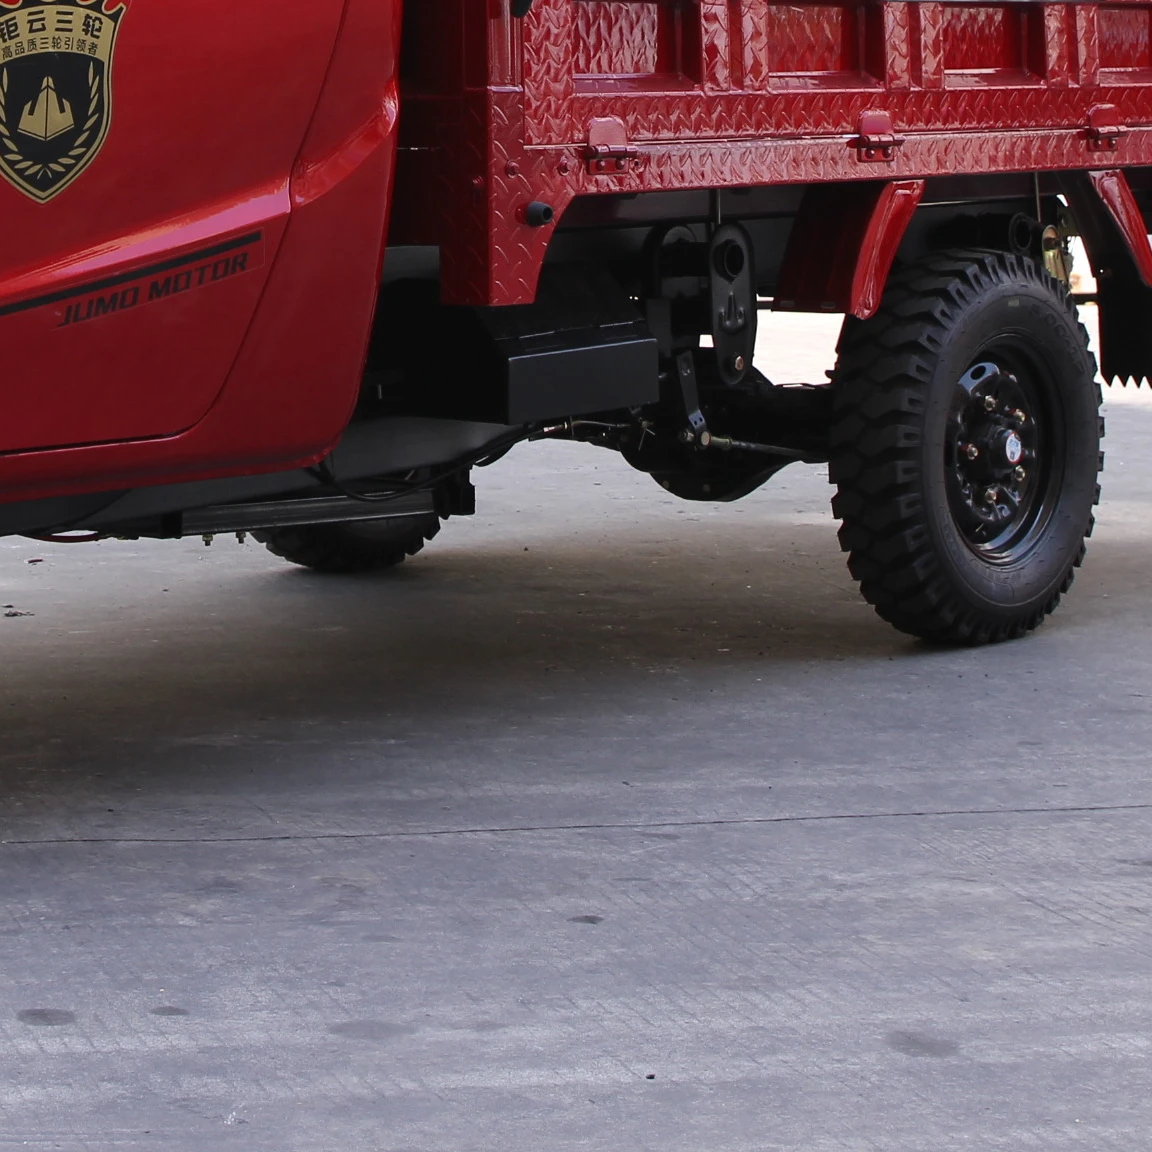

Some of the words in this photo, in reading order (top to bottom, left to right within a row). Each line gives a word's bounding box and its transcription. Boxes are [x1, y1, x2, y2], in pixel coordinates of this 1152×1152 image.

[1, 35, 100, 61] 高品质三轮引领者
[57, 285, 141, 328] JUMO
[148, 251, 249, 299] MOTOR
